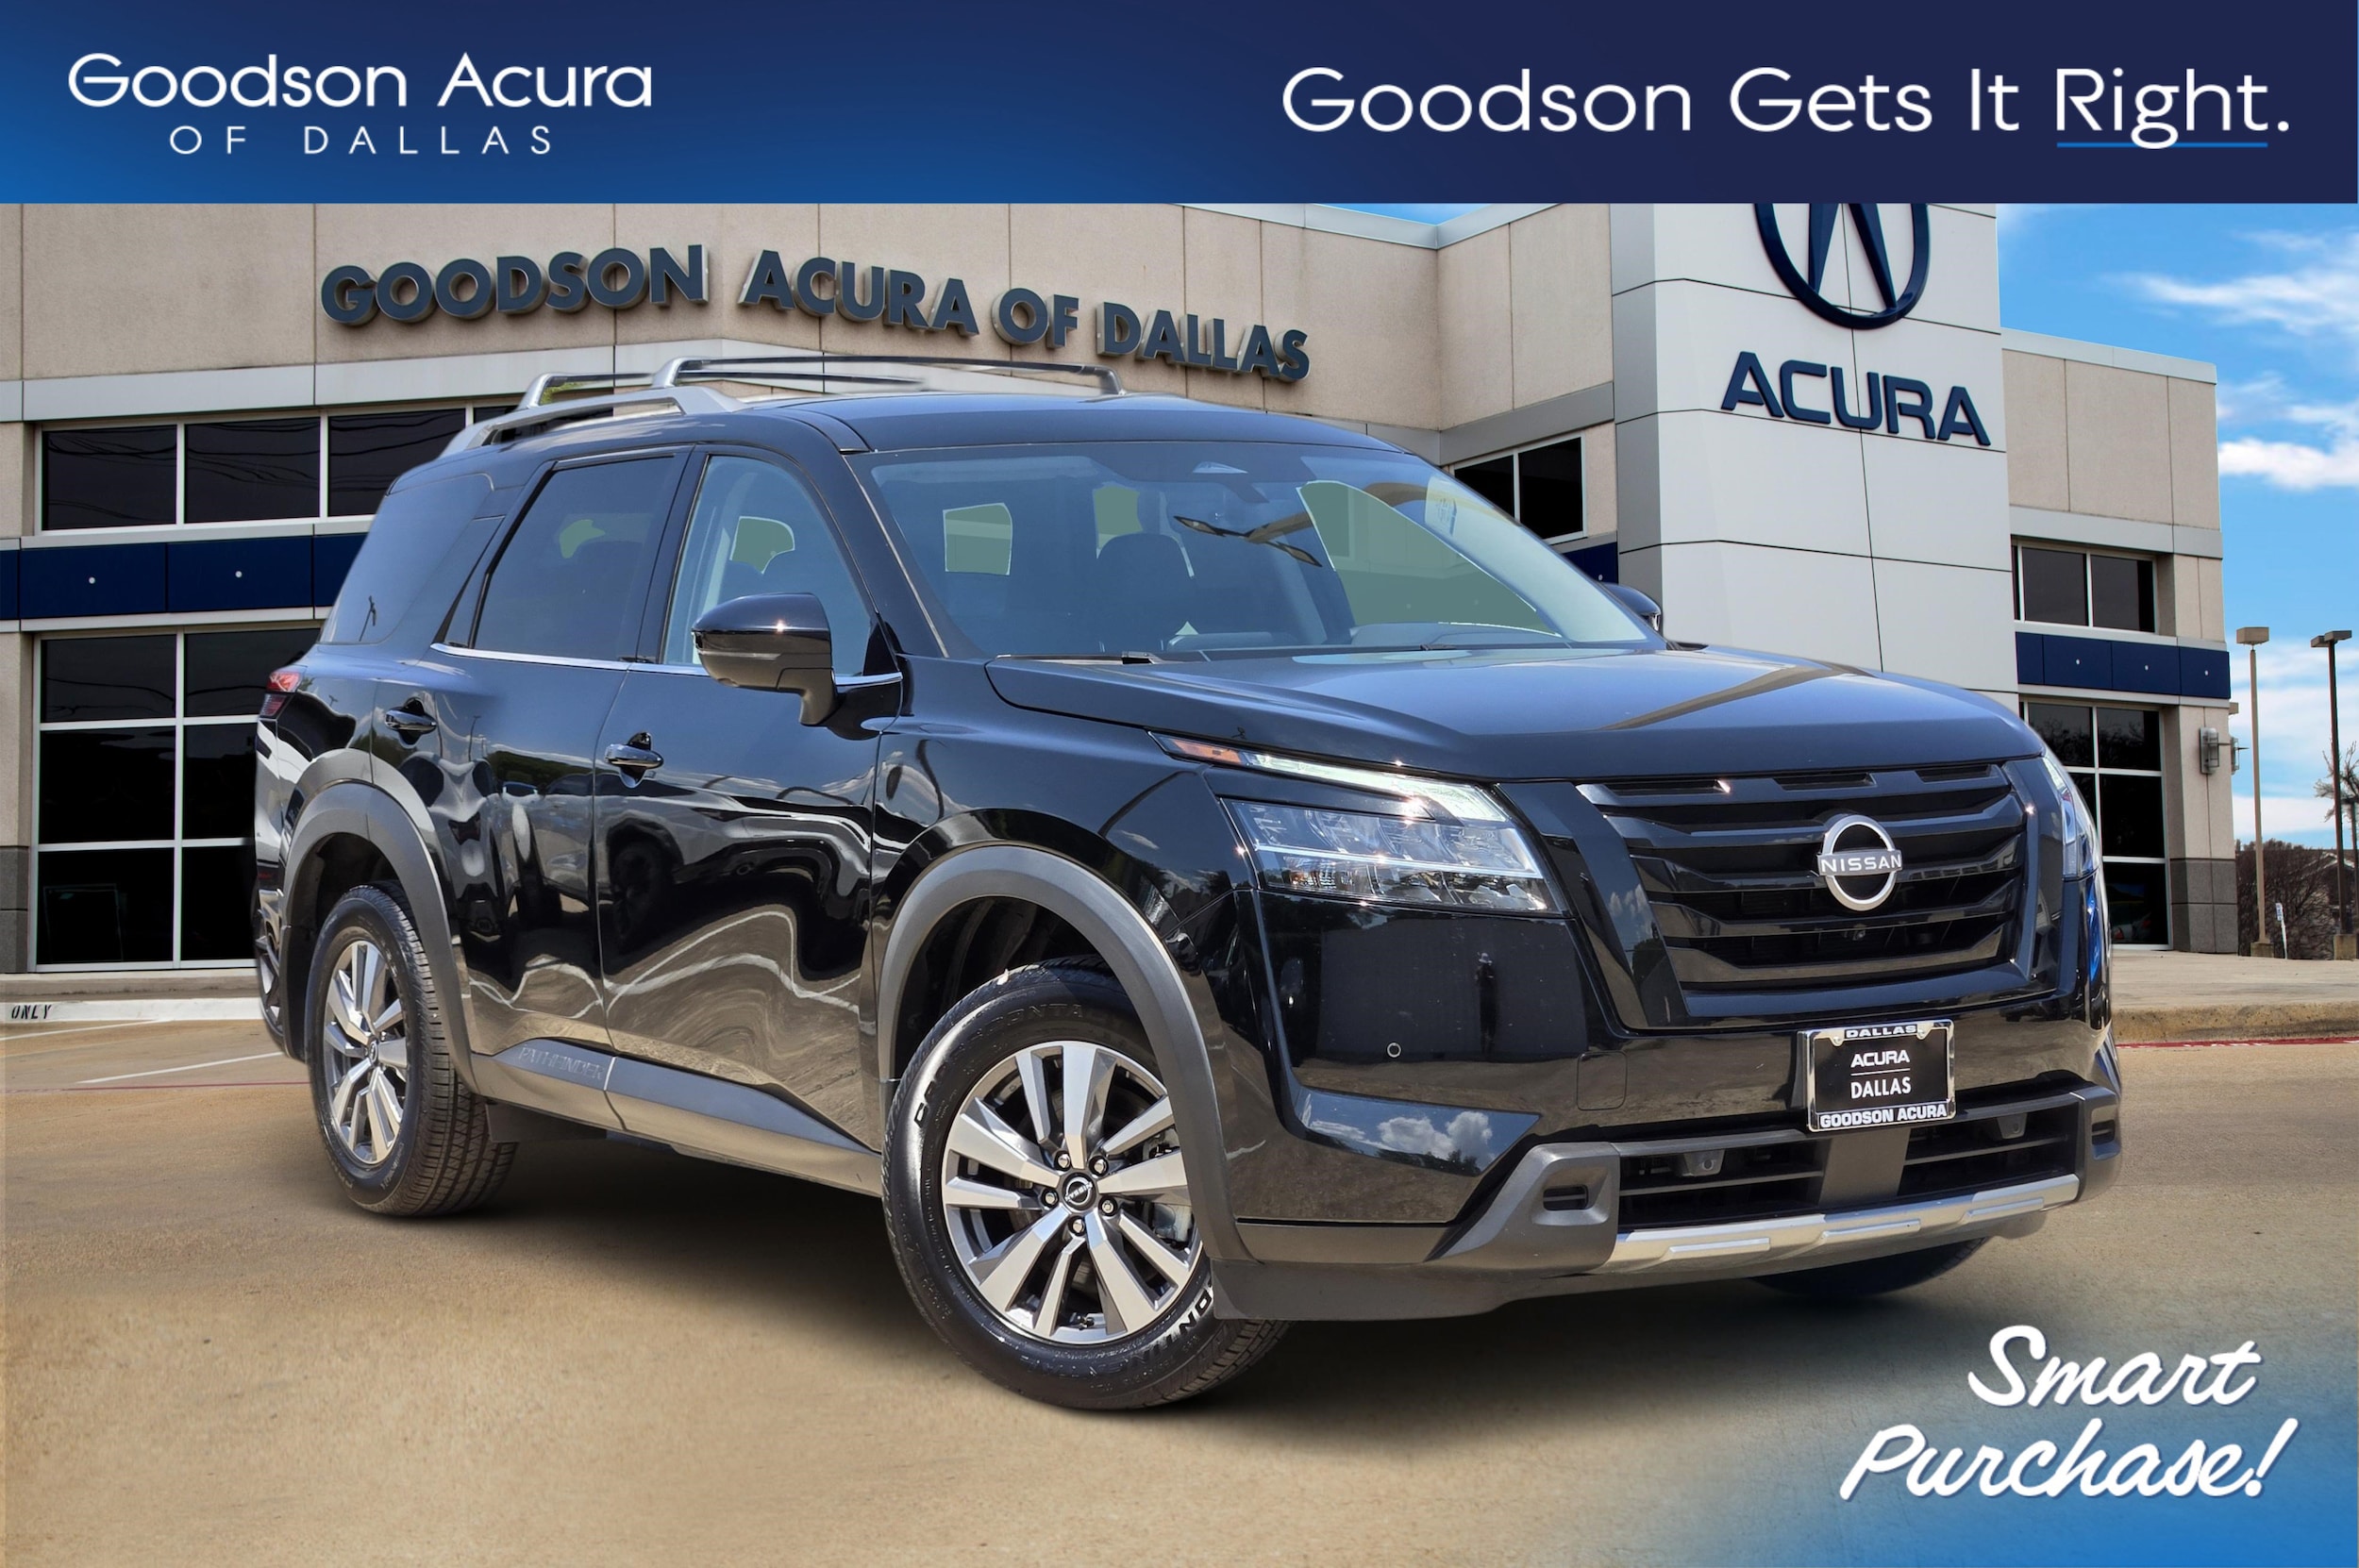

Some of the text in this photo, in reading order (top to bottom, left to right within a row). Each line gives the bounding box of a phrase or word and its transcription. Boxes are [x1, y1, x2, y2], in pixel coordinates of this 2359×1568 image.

[321, 244, 1311, 383] GOODSON ACURA OF DALLAS
[1720, 351, 1992, 446] ACURA
[1820, 854, 1902, 873] NISSAN
[11, 1004, 52, 1020] ONLY
[1846, 1025, 1916, 1039] DALLAS
[518, 1044, 605, 1080] PATHFINDER
[1850, 1049, 1911, 1068] ACURA
[1850, 1076, 1912, 1099] DALLAS
[1820, 1103, 1948, 1128] GOODSON ACURA
